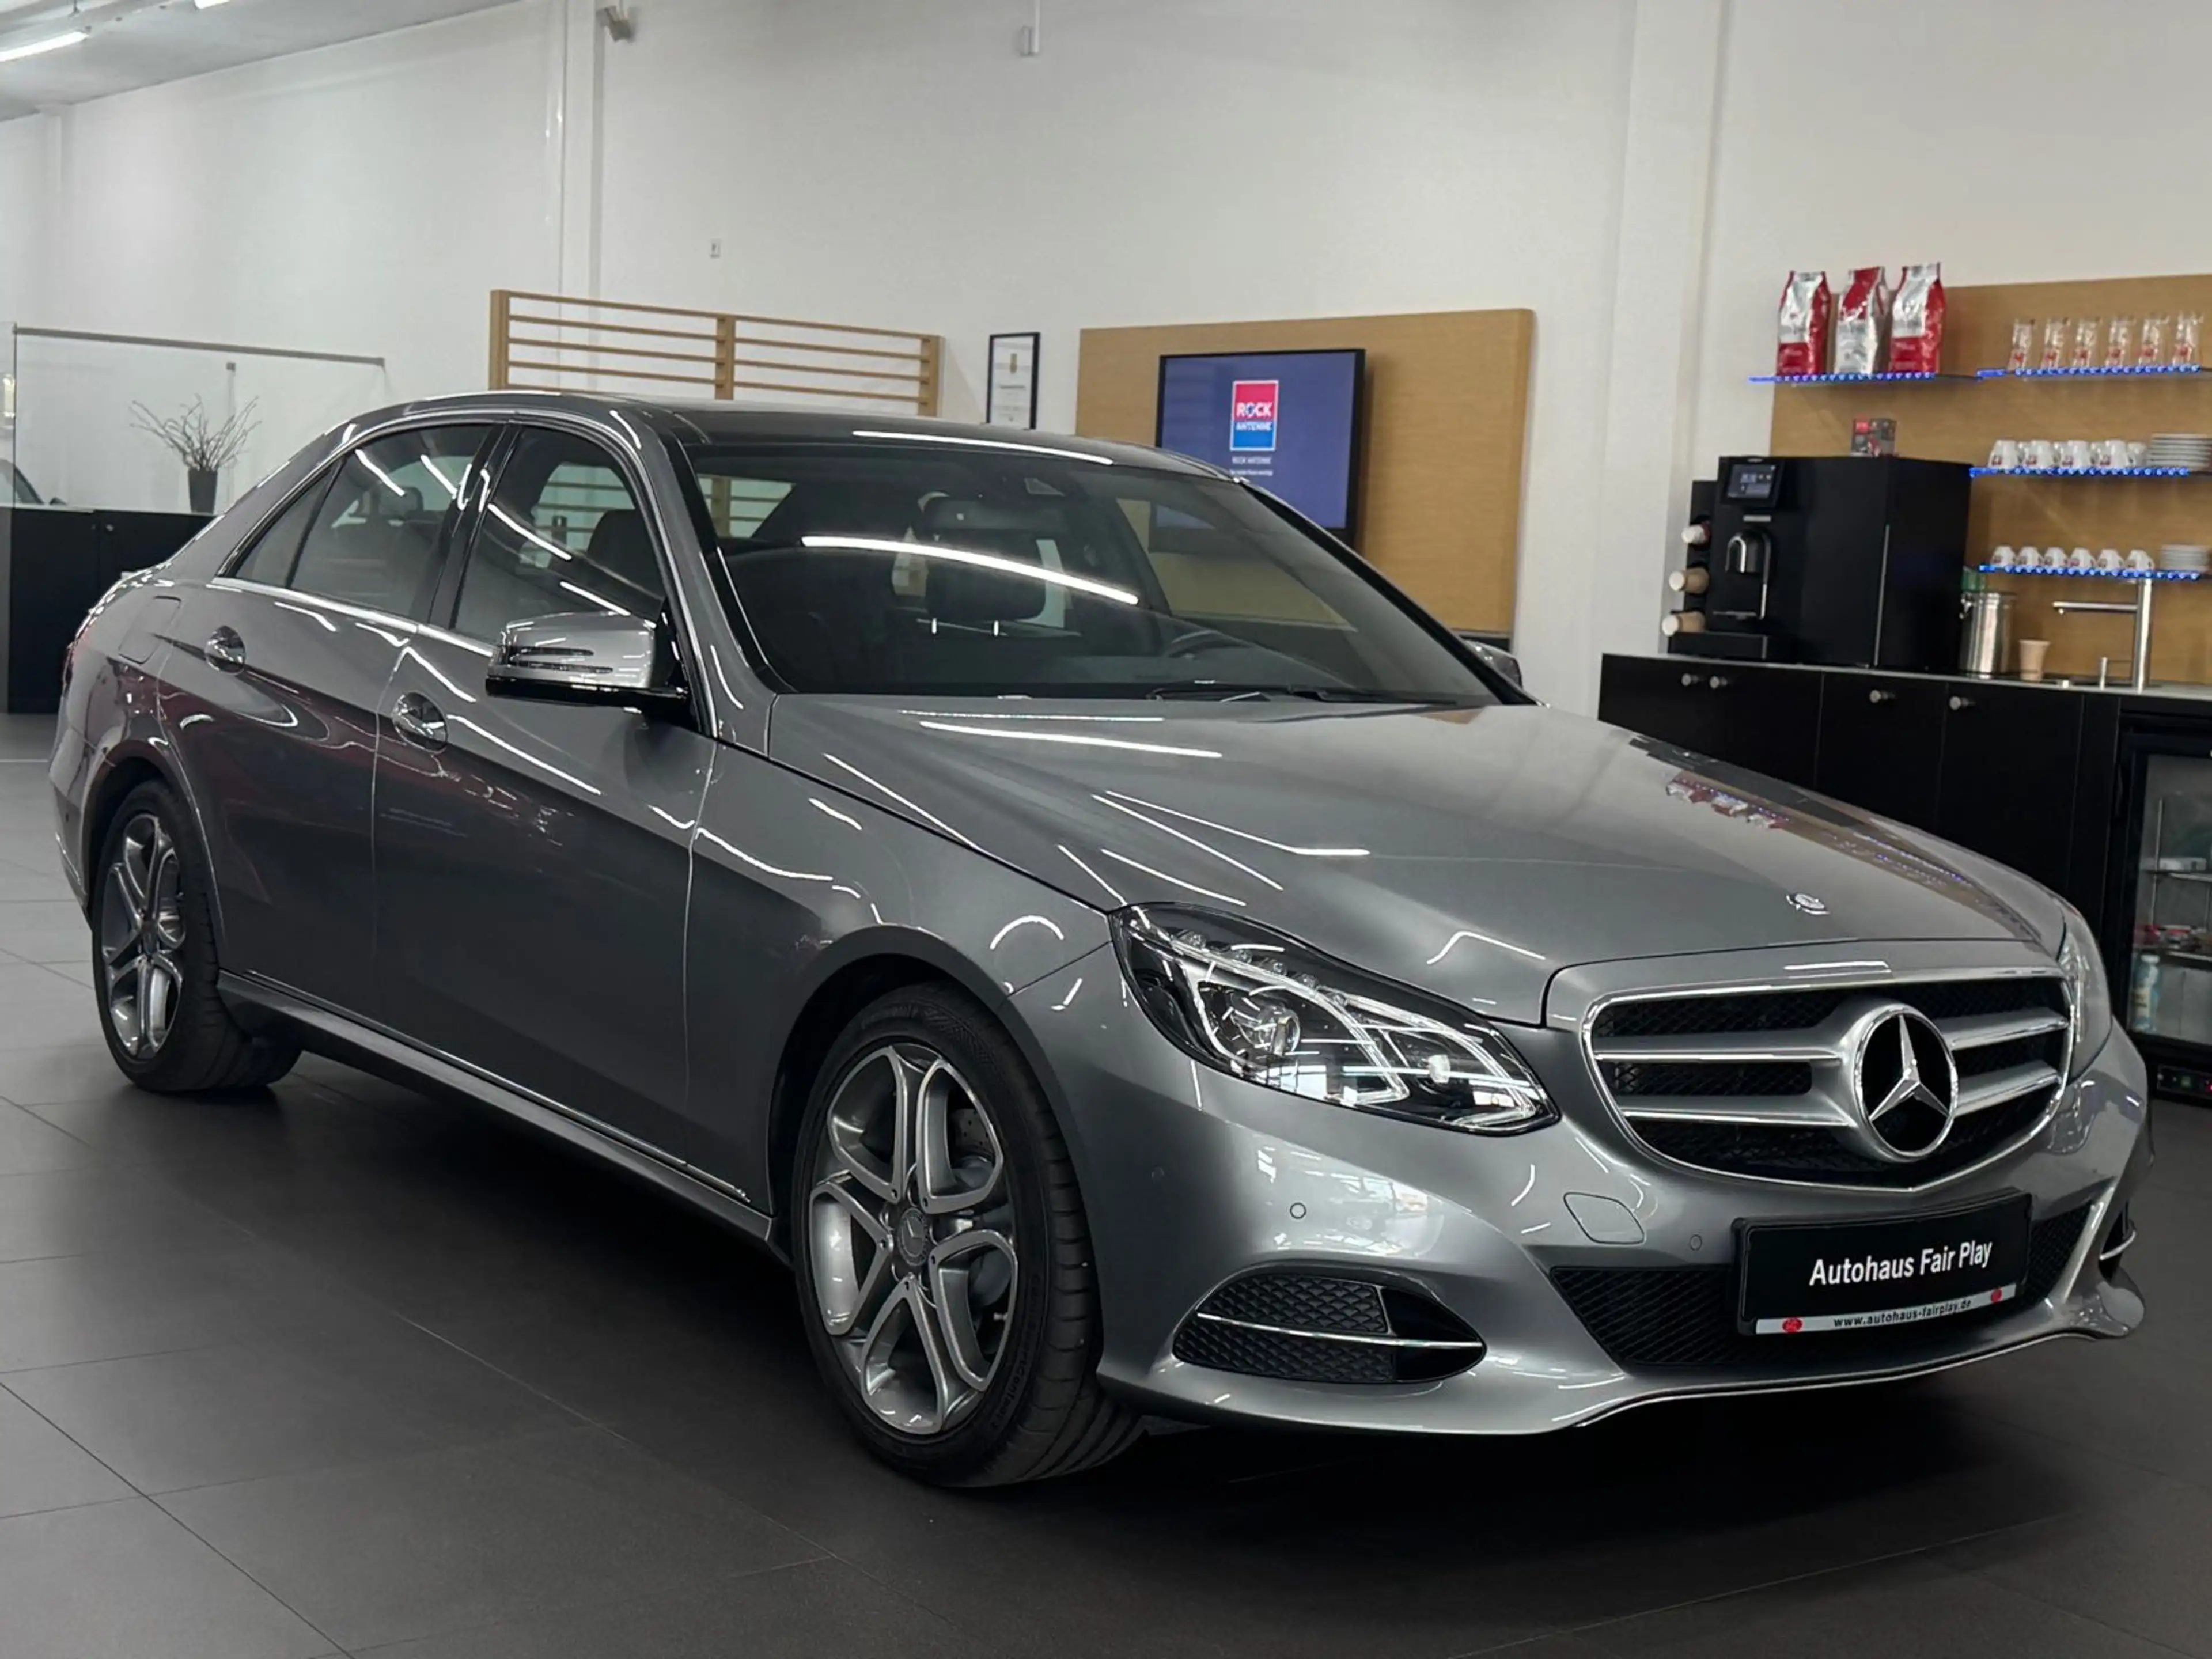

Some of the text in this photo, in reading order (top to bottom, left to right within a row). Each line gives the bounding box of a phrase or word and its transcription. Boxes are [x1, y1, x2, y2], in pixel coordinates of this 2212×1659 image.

[1236, 402, 1272, 417] ROCK
[1809, 1240, 1992, 1286] Autohaus Fair Play
[1833, 1300, 1972, 1328] www.autohaus-fairplay.de
